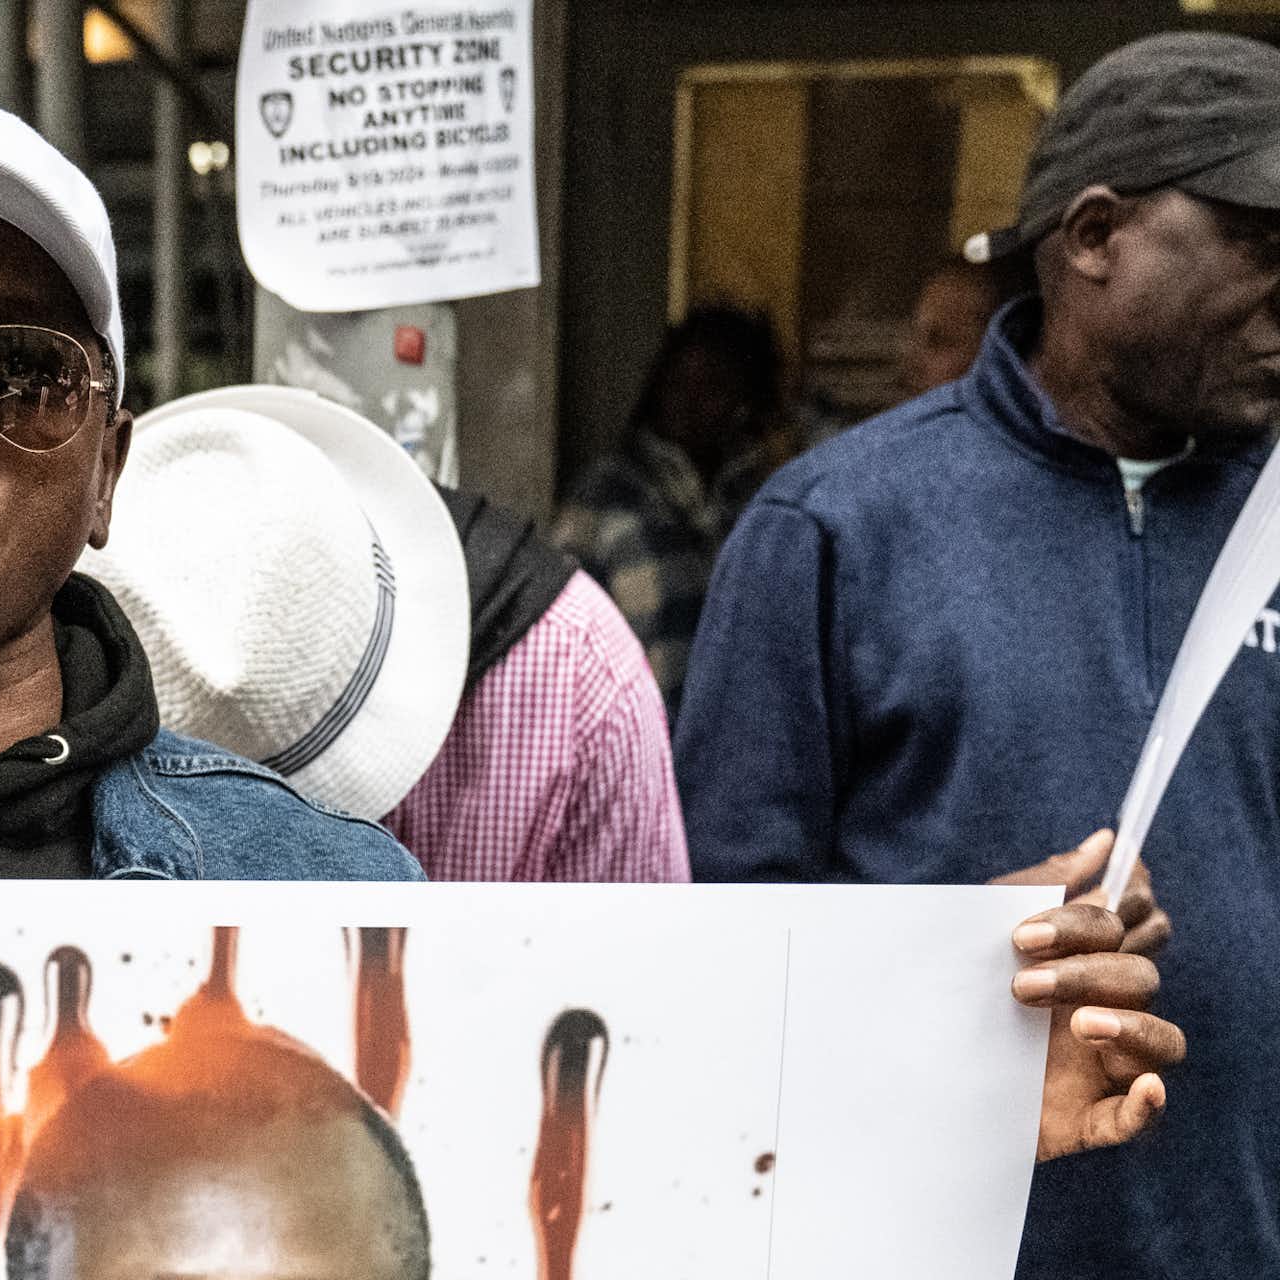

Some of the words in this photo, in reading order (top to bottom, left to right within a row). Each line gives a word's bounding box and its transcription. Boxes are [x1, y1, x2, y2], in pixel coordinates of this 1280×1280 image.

[288, 43, 443, 80] SECURITY
[328, 86, 367, 108] NO
[280, 131, 427, 165] INCLUDING
